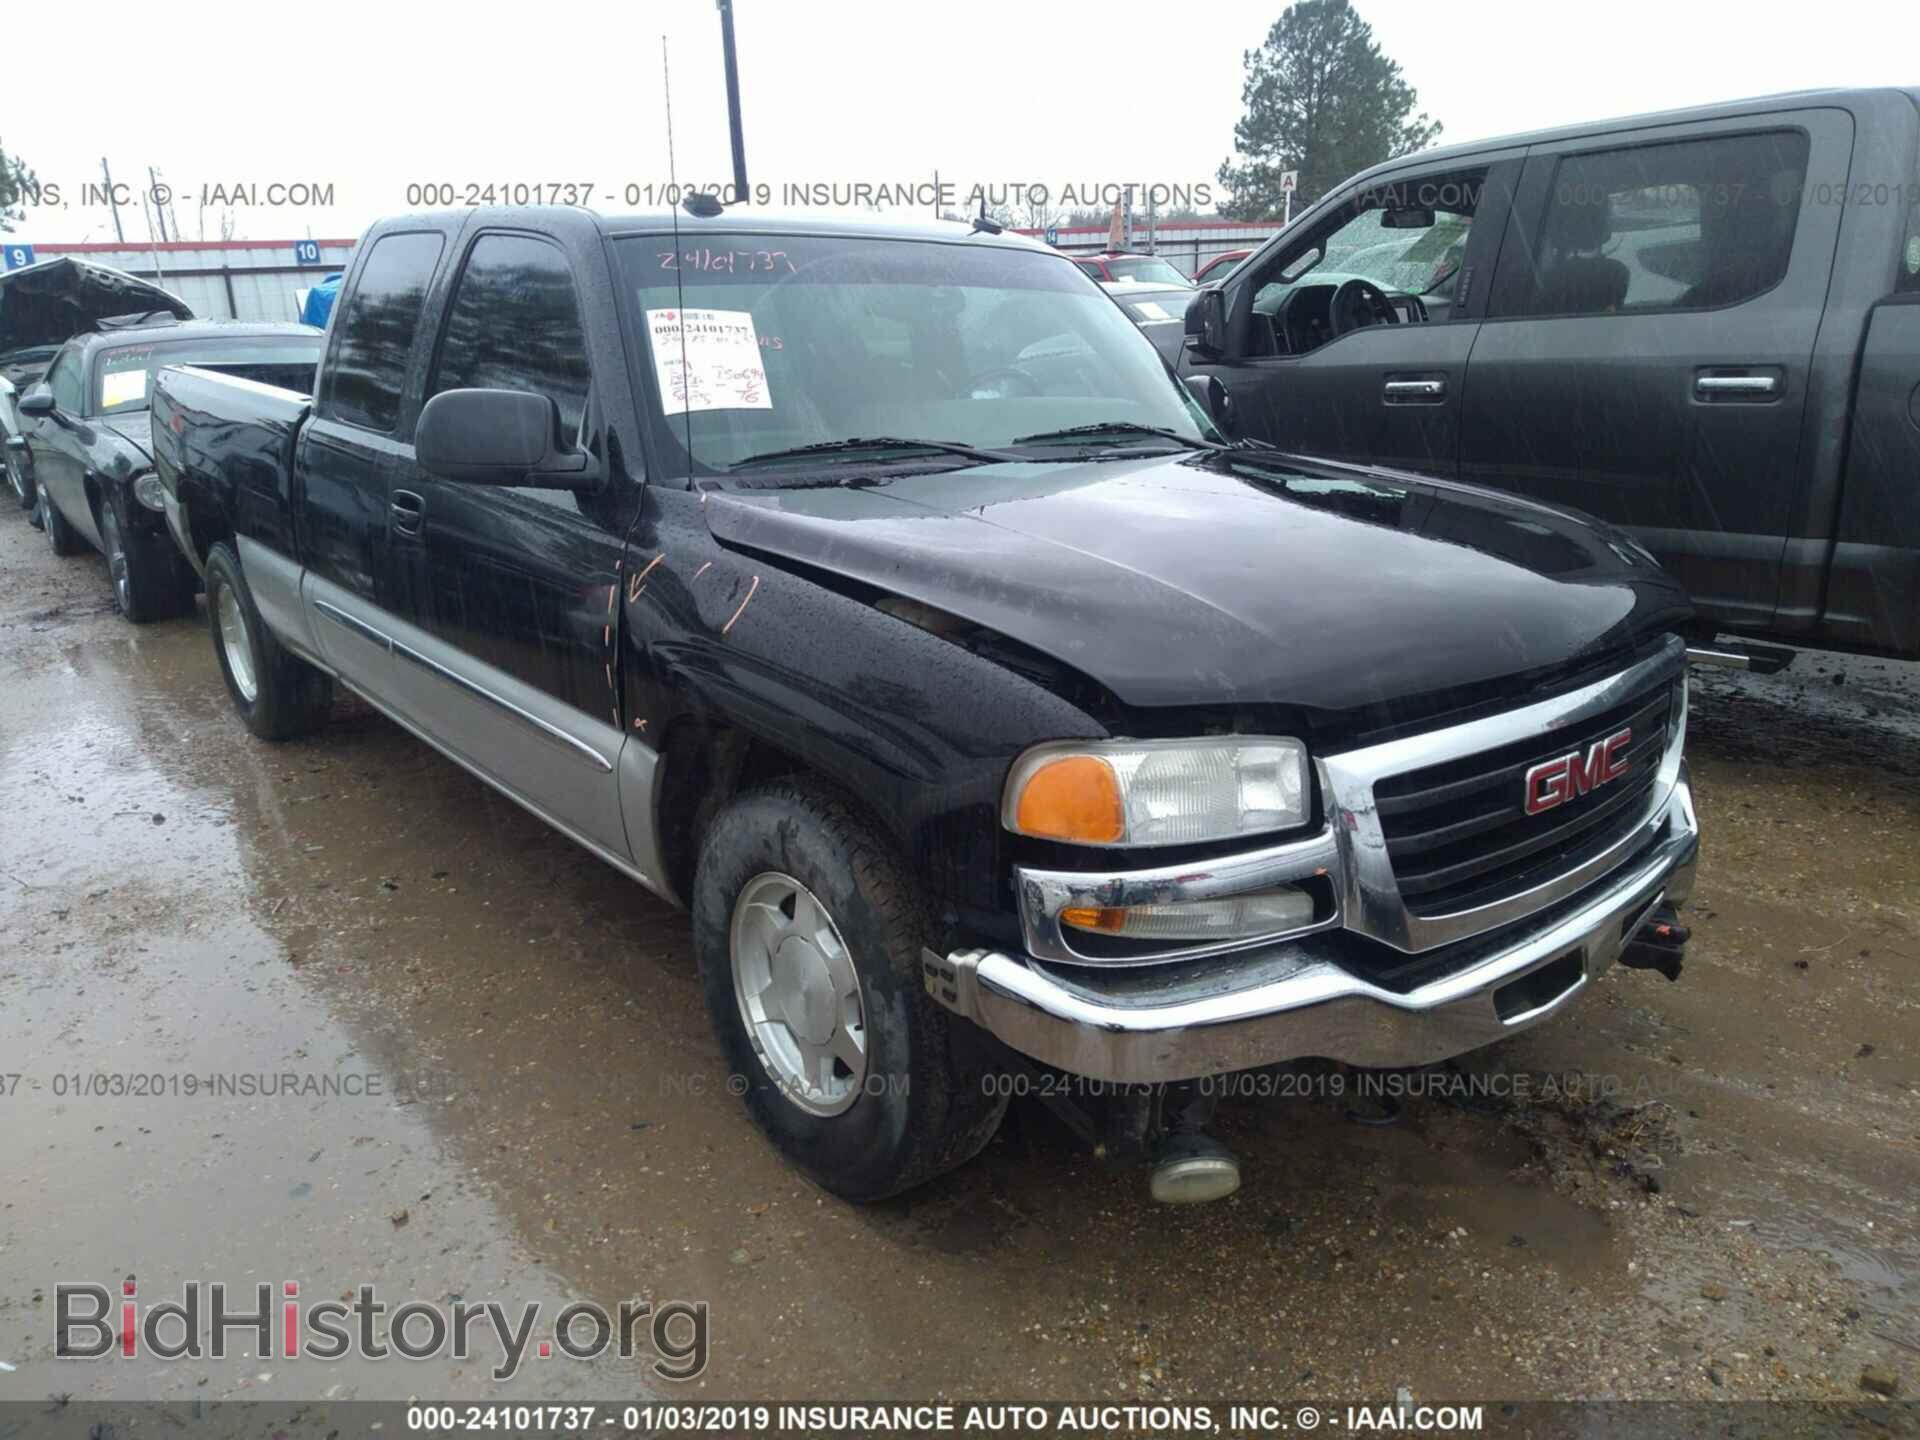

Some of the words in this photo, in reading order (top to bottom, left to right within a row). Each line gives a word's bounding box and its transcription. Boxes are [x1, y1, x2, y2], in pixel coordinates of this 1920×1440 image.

[1283, 175, 1293, 188] A
[12, 249, 26, 266] 9
[298, 243, 317, 260] 10
[1525, 727, 1632, 815] GMC
